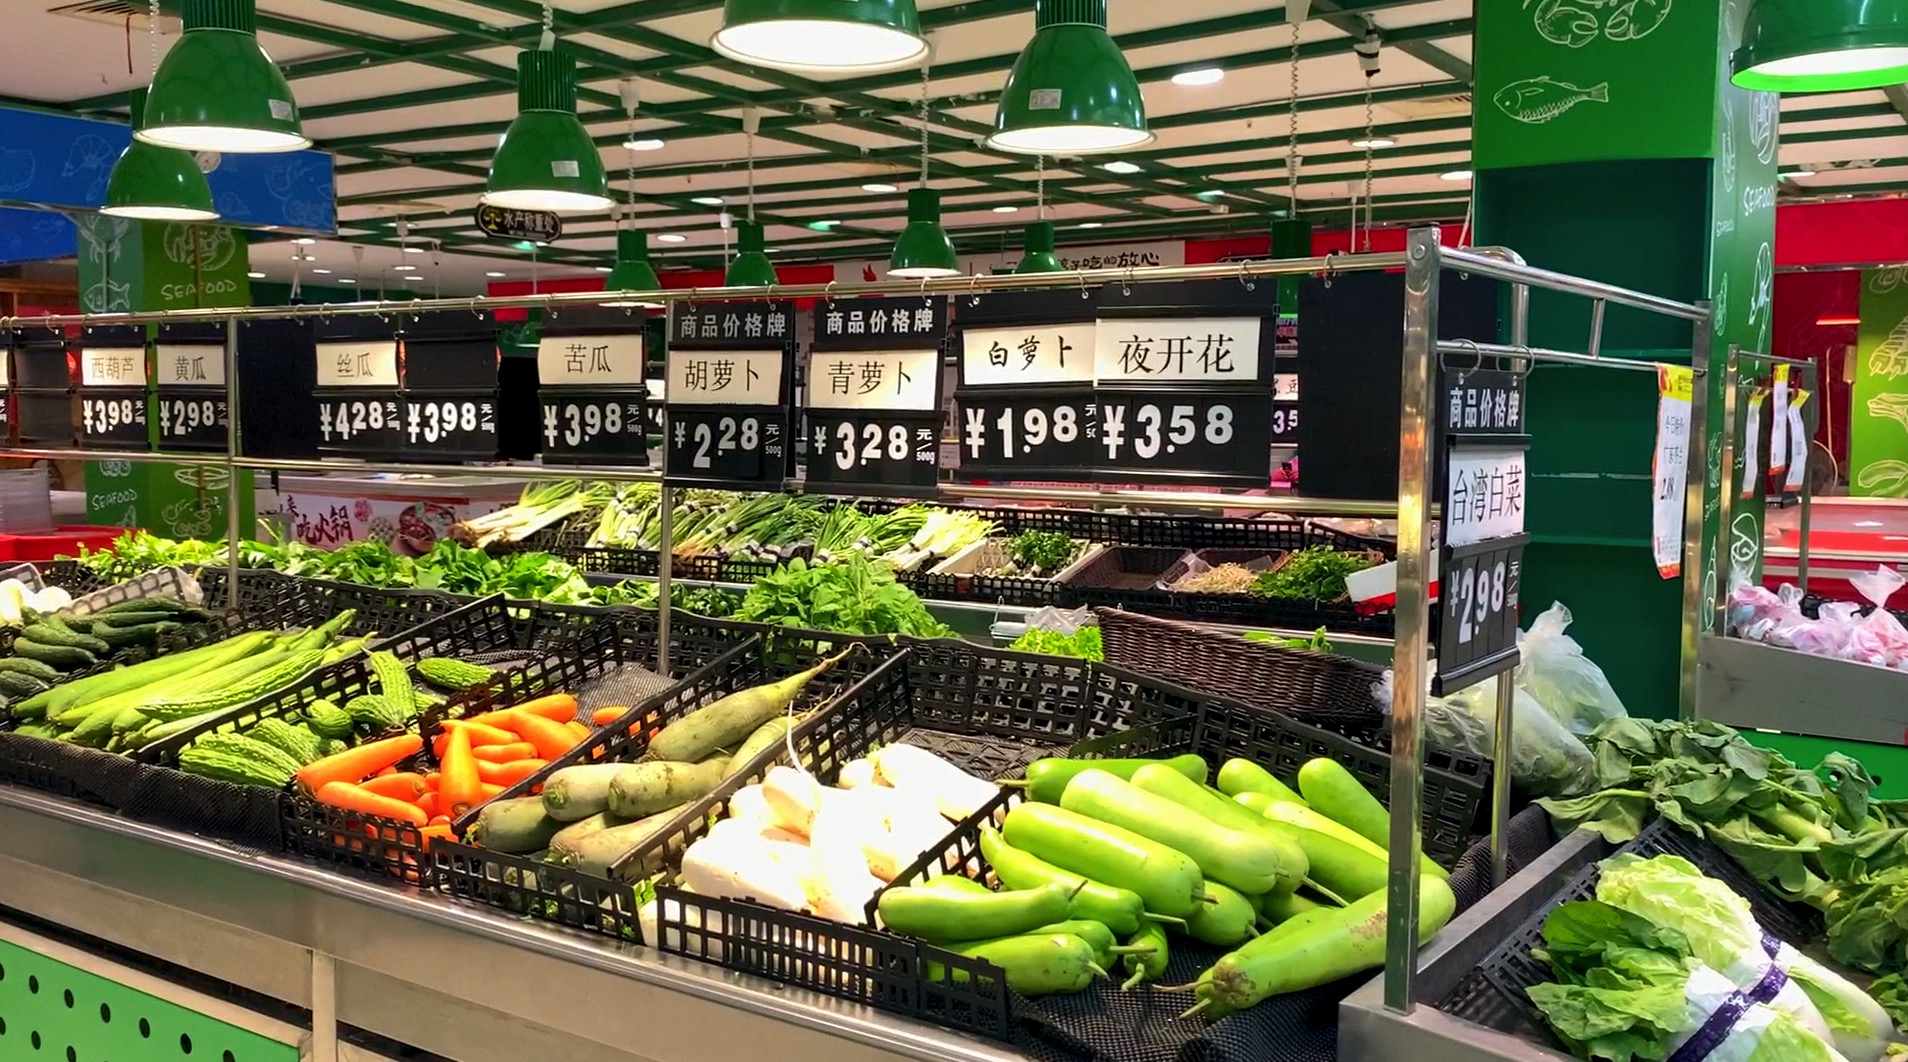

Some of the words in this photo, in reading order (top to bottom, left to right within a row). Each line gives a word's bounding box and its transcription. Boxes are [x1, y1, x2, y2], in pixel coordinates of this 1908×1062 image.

[160, 279, 237, 300] SEAFOOD
[680, 313, 786, 339] 商品价格牌
[826, 308, 934, 335] 商品价格牌
[337, 352, 374, 378] 丝瓜
[564, 343, 612, 374] 苦瓜
[987, 334, 1073, 371] 白萝卜
[1117, 334, 1235, 375] 夜开花
[91, 356, 135, 380] 西葫芦
[175, 356, 207, 381] 黄瓜
[684, 359, 761, 392] 胡萝卜
[827, 360, 912, 396] 青萝卜
[1449, 387, 1520, 429] 商品价格牌
[91, 488, 138, 511] SEAFOOD
[1451, 465, 1522, 527] 台湾白菜
